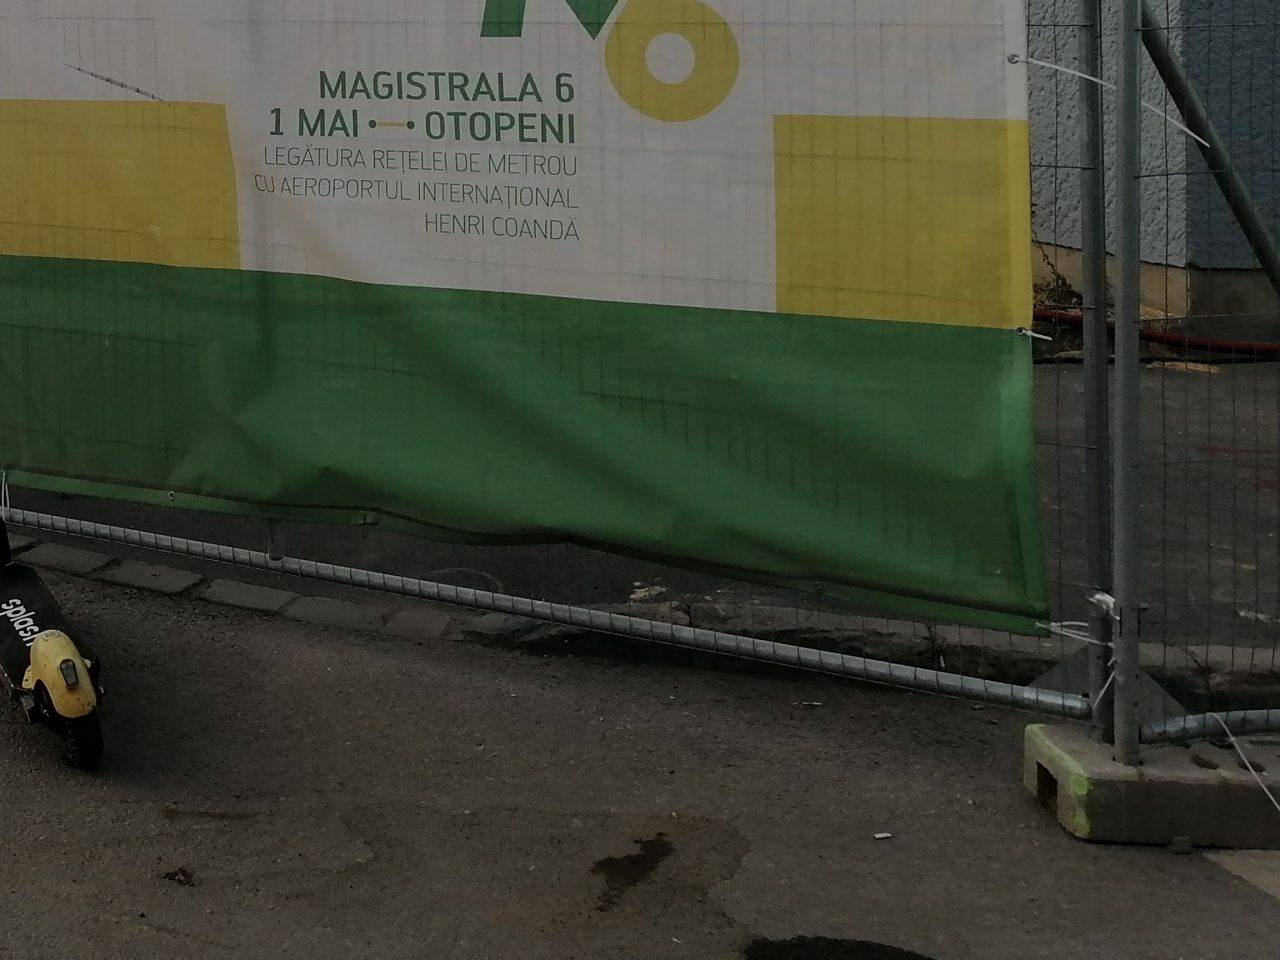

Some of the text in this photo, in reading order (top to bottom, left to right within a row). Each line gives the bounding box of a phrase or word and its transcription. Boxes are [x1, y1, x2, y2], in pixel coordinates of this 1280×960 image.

[320, 70, 575, 103] MAGISTRALA 6
[270, 107, 575, 144] 1 MAI OTOPENI
[264, 144, 367, 169] LEGĂTURA
[455, 152, 481, 173] DE
[488, 153, 577, 176] METROU
[254, 174, 275, 193] CU
[280, 176, 411, 201] AEROPORTUL
[425, 213, 580, 241] HENRI COANDĂ
